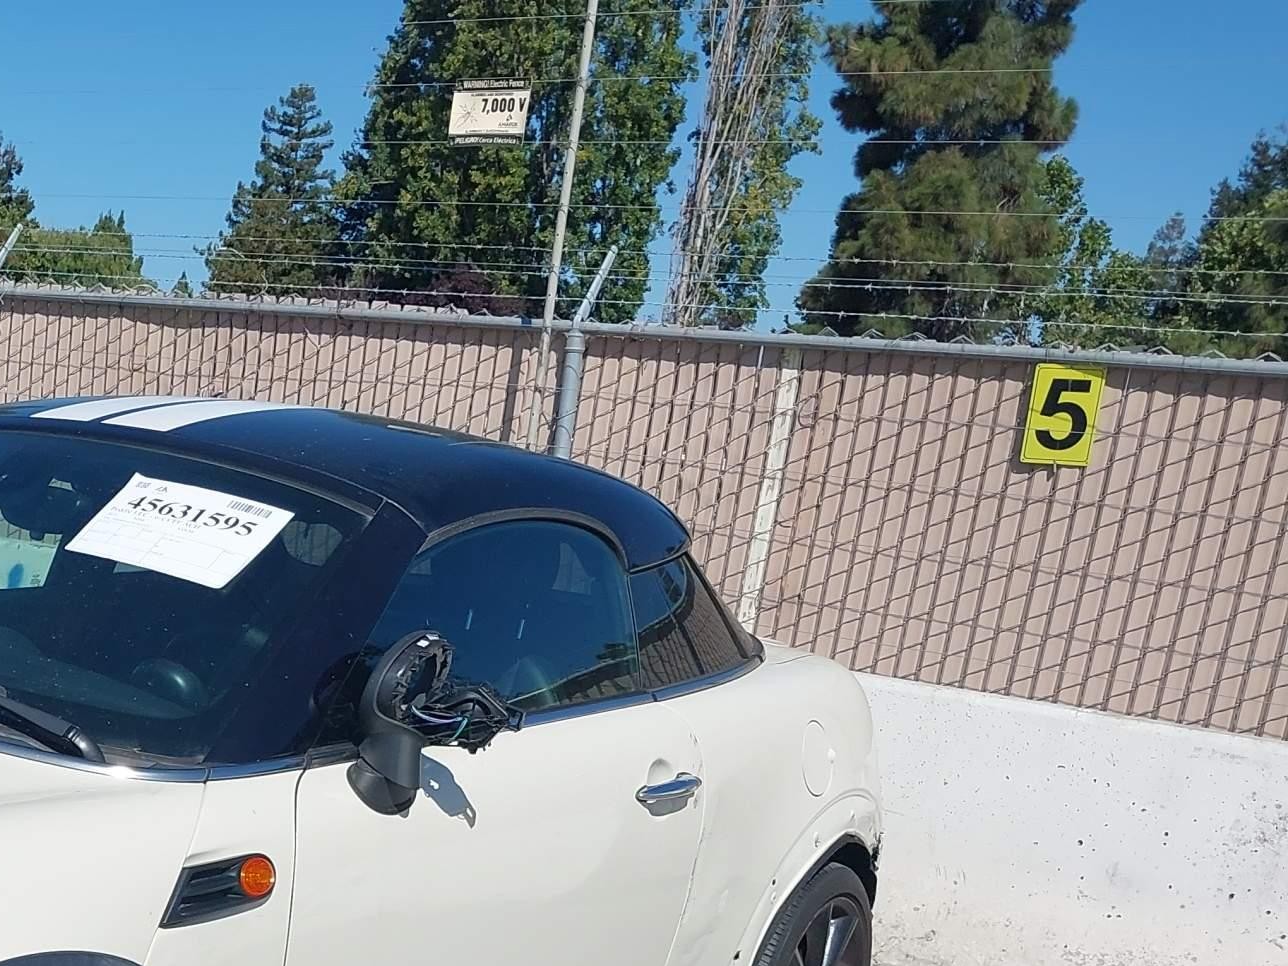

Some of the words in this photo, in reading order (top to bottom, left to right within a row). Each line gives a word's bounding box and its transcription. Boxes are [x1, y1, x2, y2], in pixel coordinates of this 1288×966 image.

[481, 98, 515, 115] 7,000
[519, 97, 526, 112] V
[1035, 378, 1092, 451] 5
[127, 496, 260, 536] 45631595
